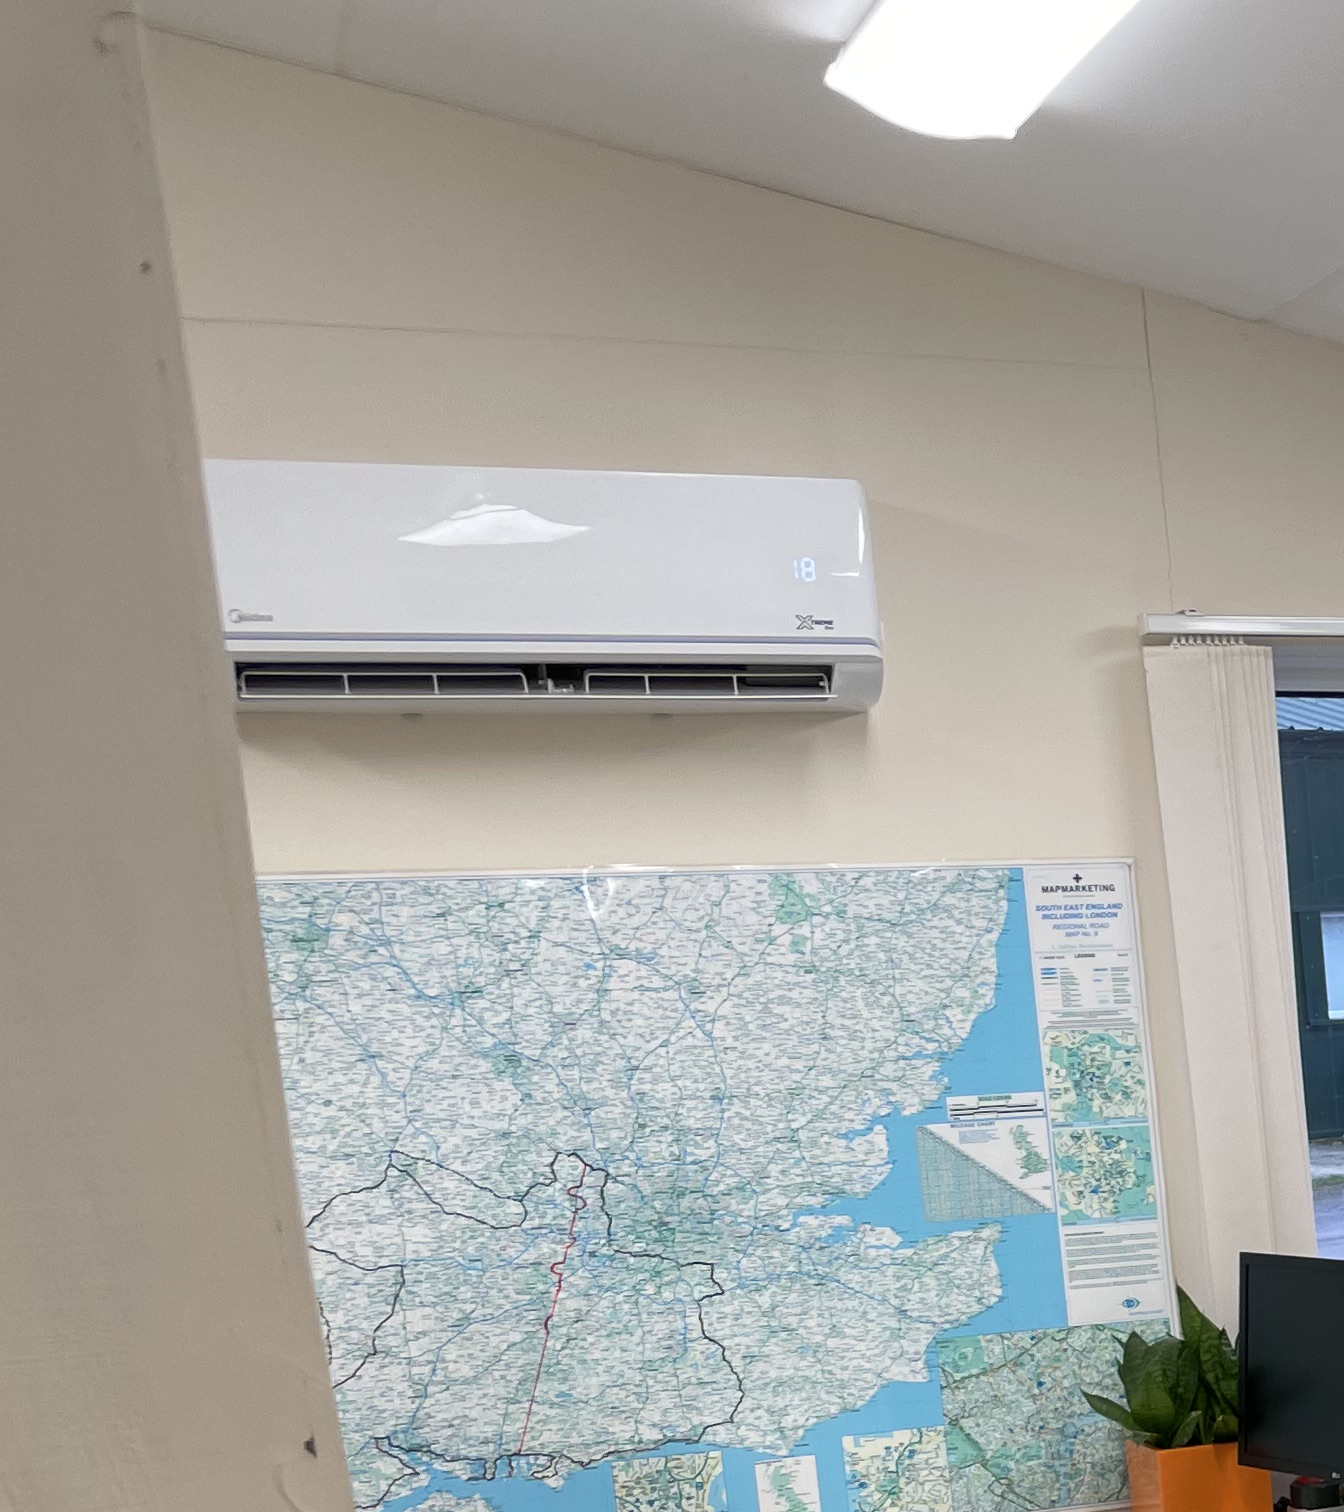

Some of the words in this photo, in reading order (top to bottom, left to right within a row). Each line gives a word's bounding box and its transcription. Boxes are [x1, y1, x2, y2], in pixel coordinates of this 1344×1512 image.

[792, 556, 817, 582] 18
[1041, 884, 1116, 894] MAPMARKETING
[1035, 904, 1062, 912] SOUTH
[1063, 903, 1084, 911] EAST
[1085, 902, 1123, 910] ENGLAND
[1041, 912, 1083, 920] INCLUDING
[1085, 911, 1118, 919] LONDON
